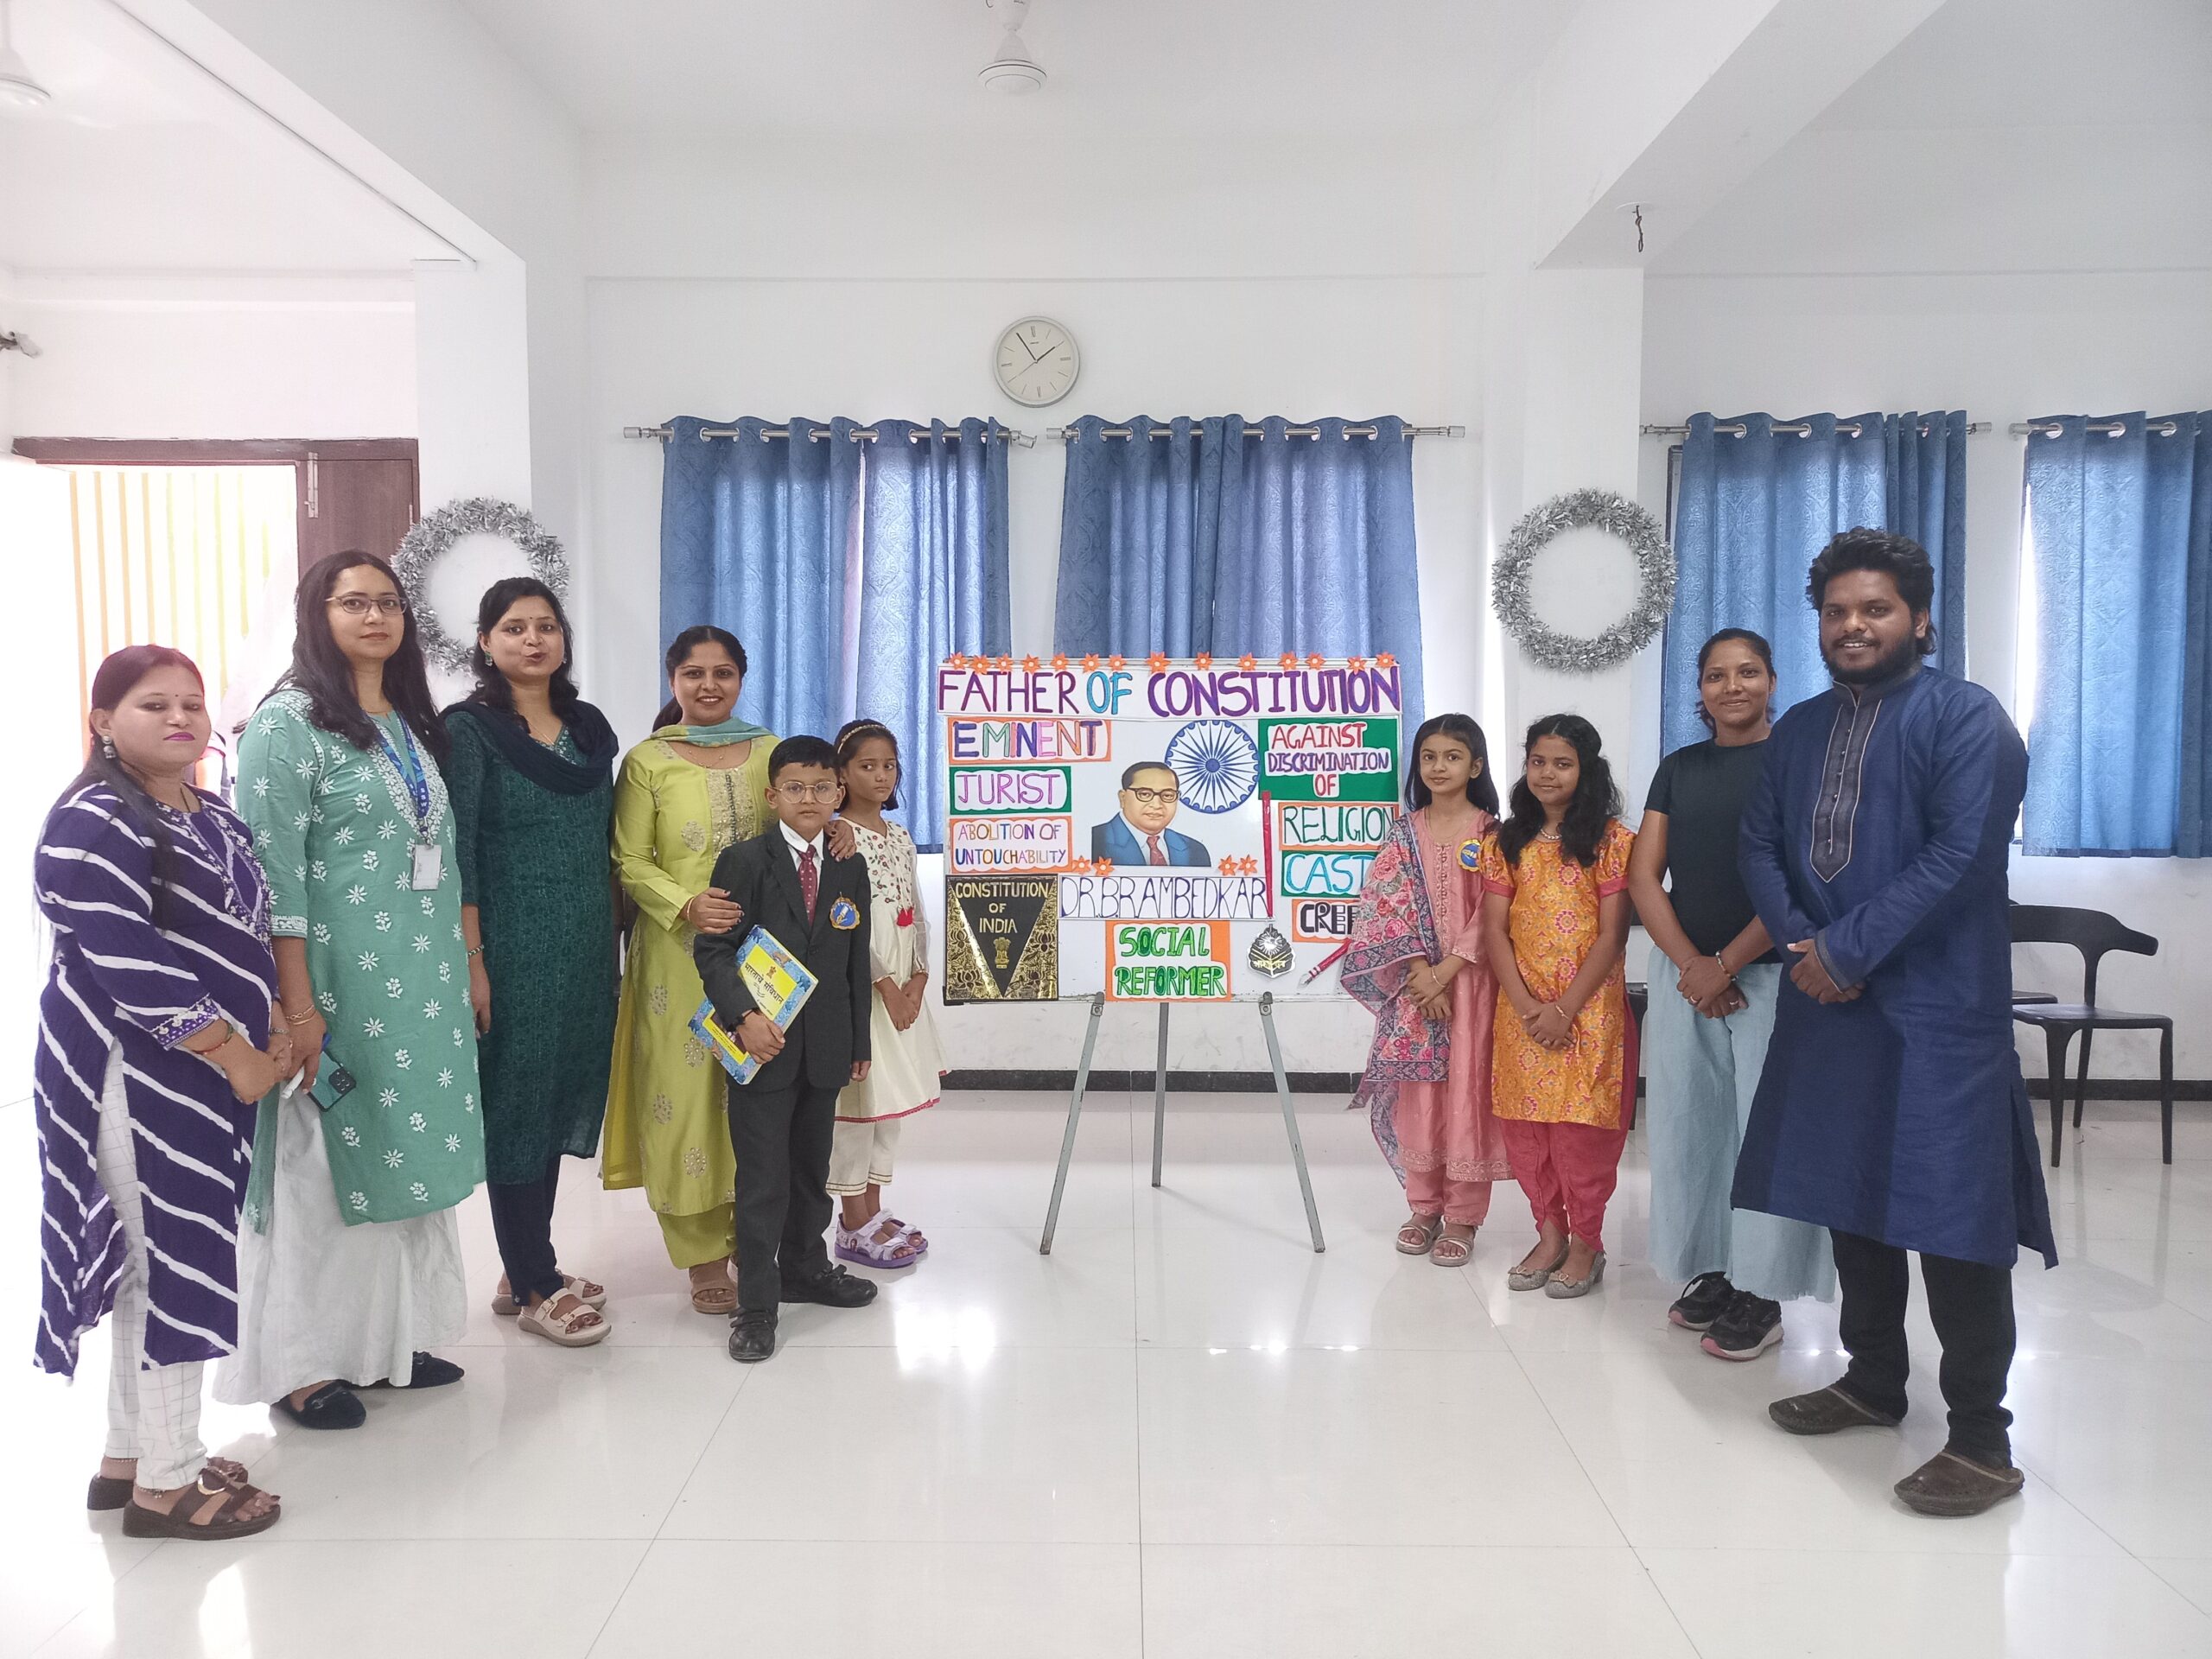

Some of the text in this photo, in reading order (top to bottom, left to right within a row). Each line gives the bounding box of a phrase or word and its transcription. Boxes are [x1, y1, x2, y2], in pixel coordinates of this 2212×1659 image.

[938, 666, 1401, 718] FATHER OF CONSTITUTION
[953, 720, 1103, 758] EMINENT
[1272, 723, 1366, 749] AGAINST
[1268, 752, 1389, 772] DISCRIMINATION
[956, 773, 1061, 804] JURIST
[1314, 774, 1337, 796] OF
[958, 823, 1062, 841] ABOLITION OF
[1282, 805, 1396, 843] RELIGION
[955, 849, 1066, 865] UNTOUCHABILITY
[1286, 854, 1376, 893] CAST
[955, 881, 1049, 898] CONSTITUTION
[988, 903, 1007, 913] OF
[1300, 902, 1359, 935] CREE
[979, 918, 1018, 934] INDIA
[1119, 927, 1210, 957] SOCIAL
[1114, 966, 1227, 996] REFORMER
